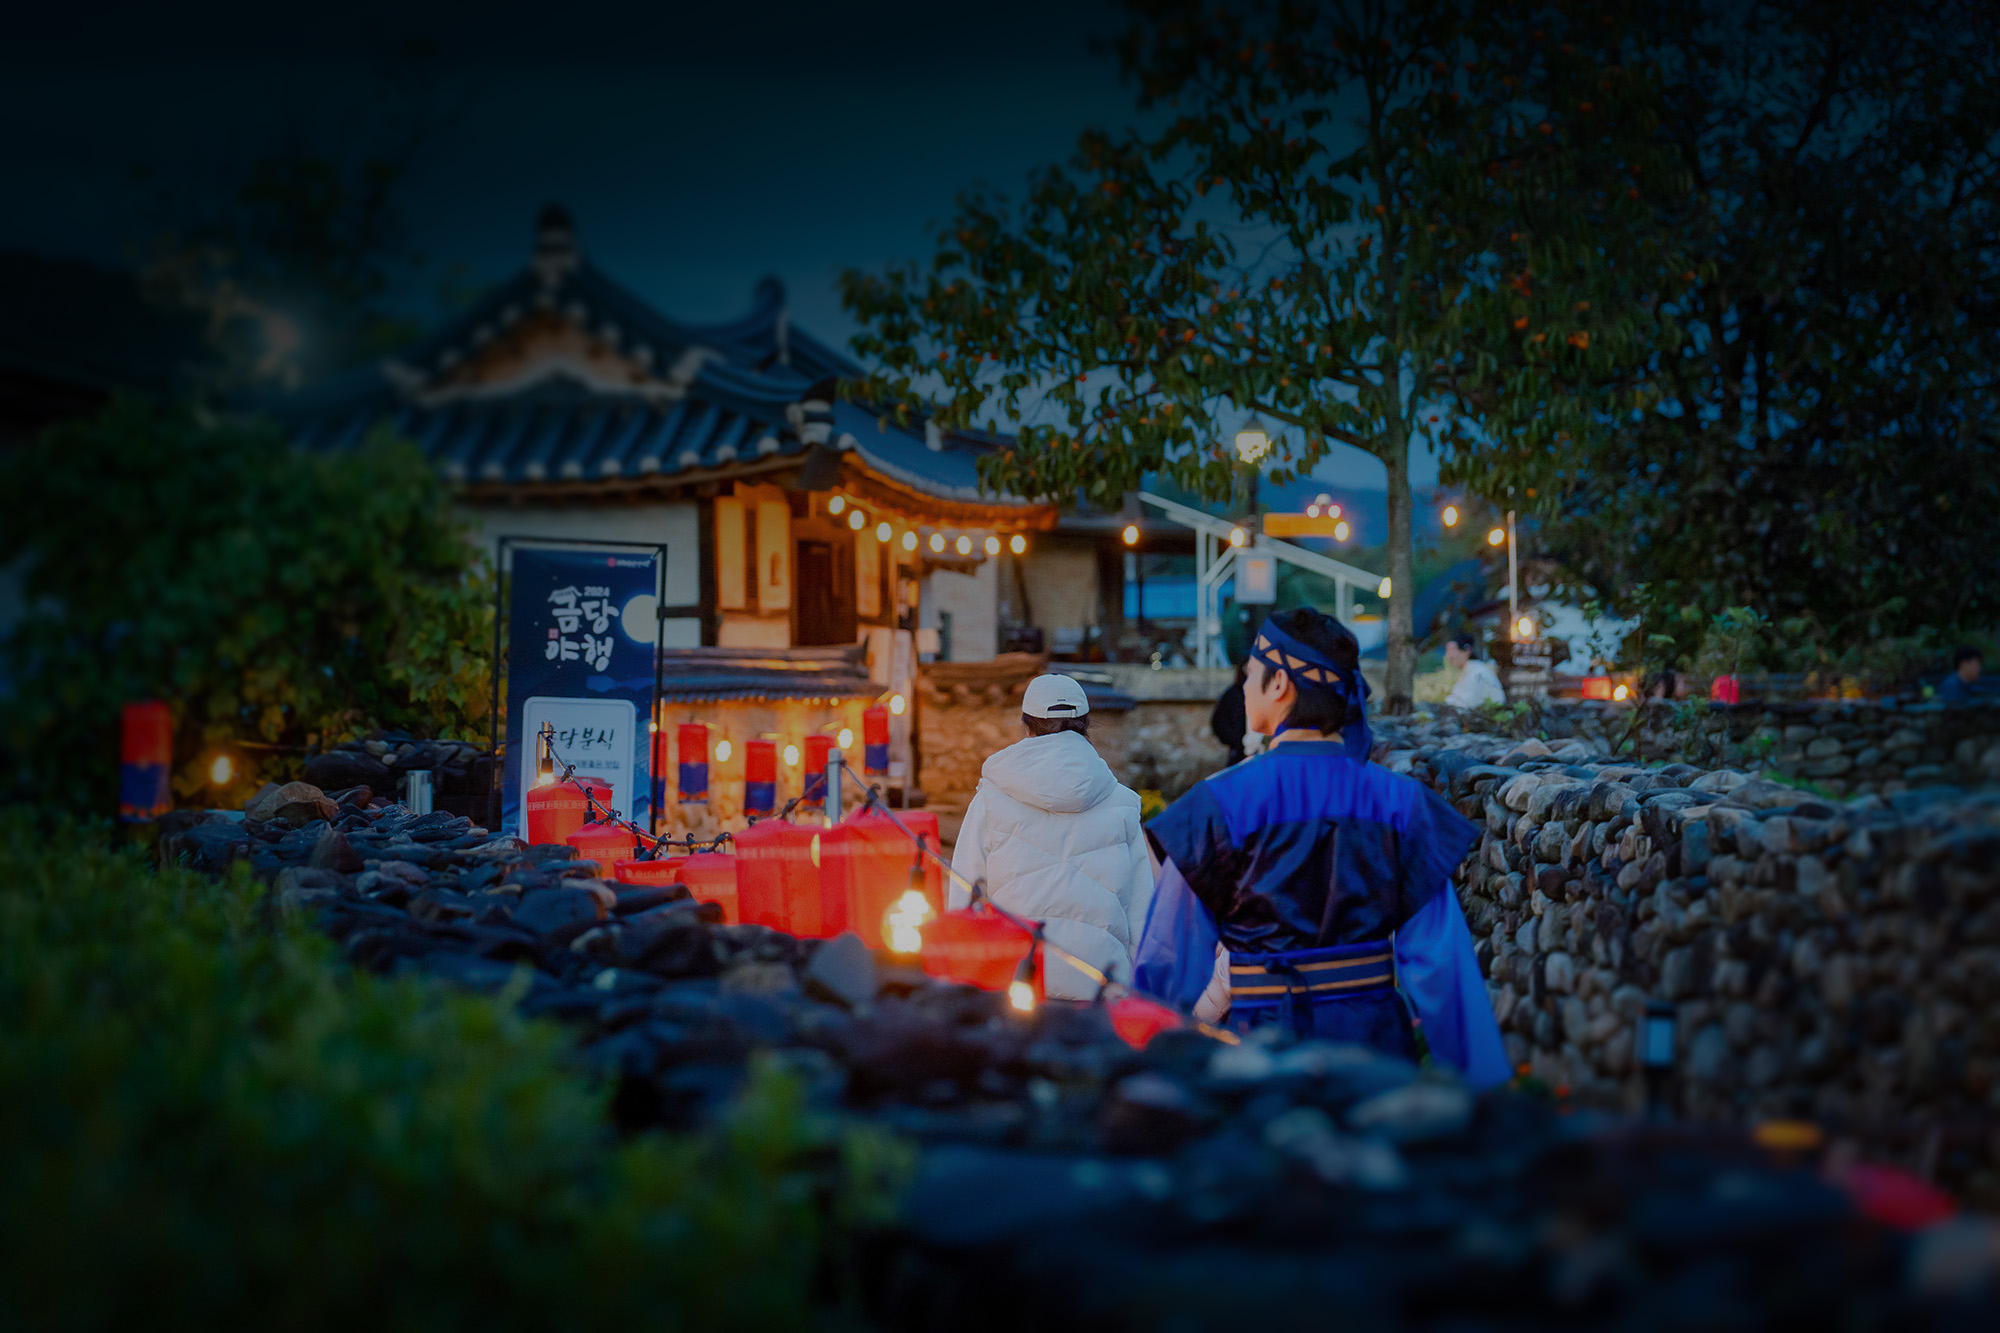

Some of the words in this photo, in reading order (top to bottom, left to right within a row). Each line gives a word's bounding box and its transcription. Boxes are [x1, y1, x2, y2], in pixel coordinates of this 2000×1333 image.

[547, 585, 619, 634] 금당
[545, 633, 614, 672] 야행
[551, 727, 615, 750] 당분식
